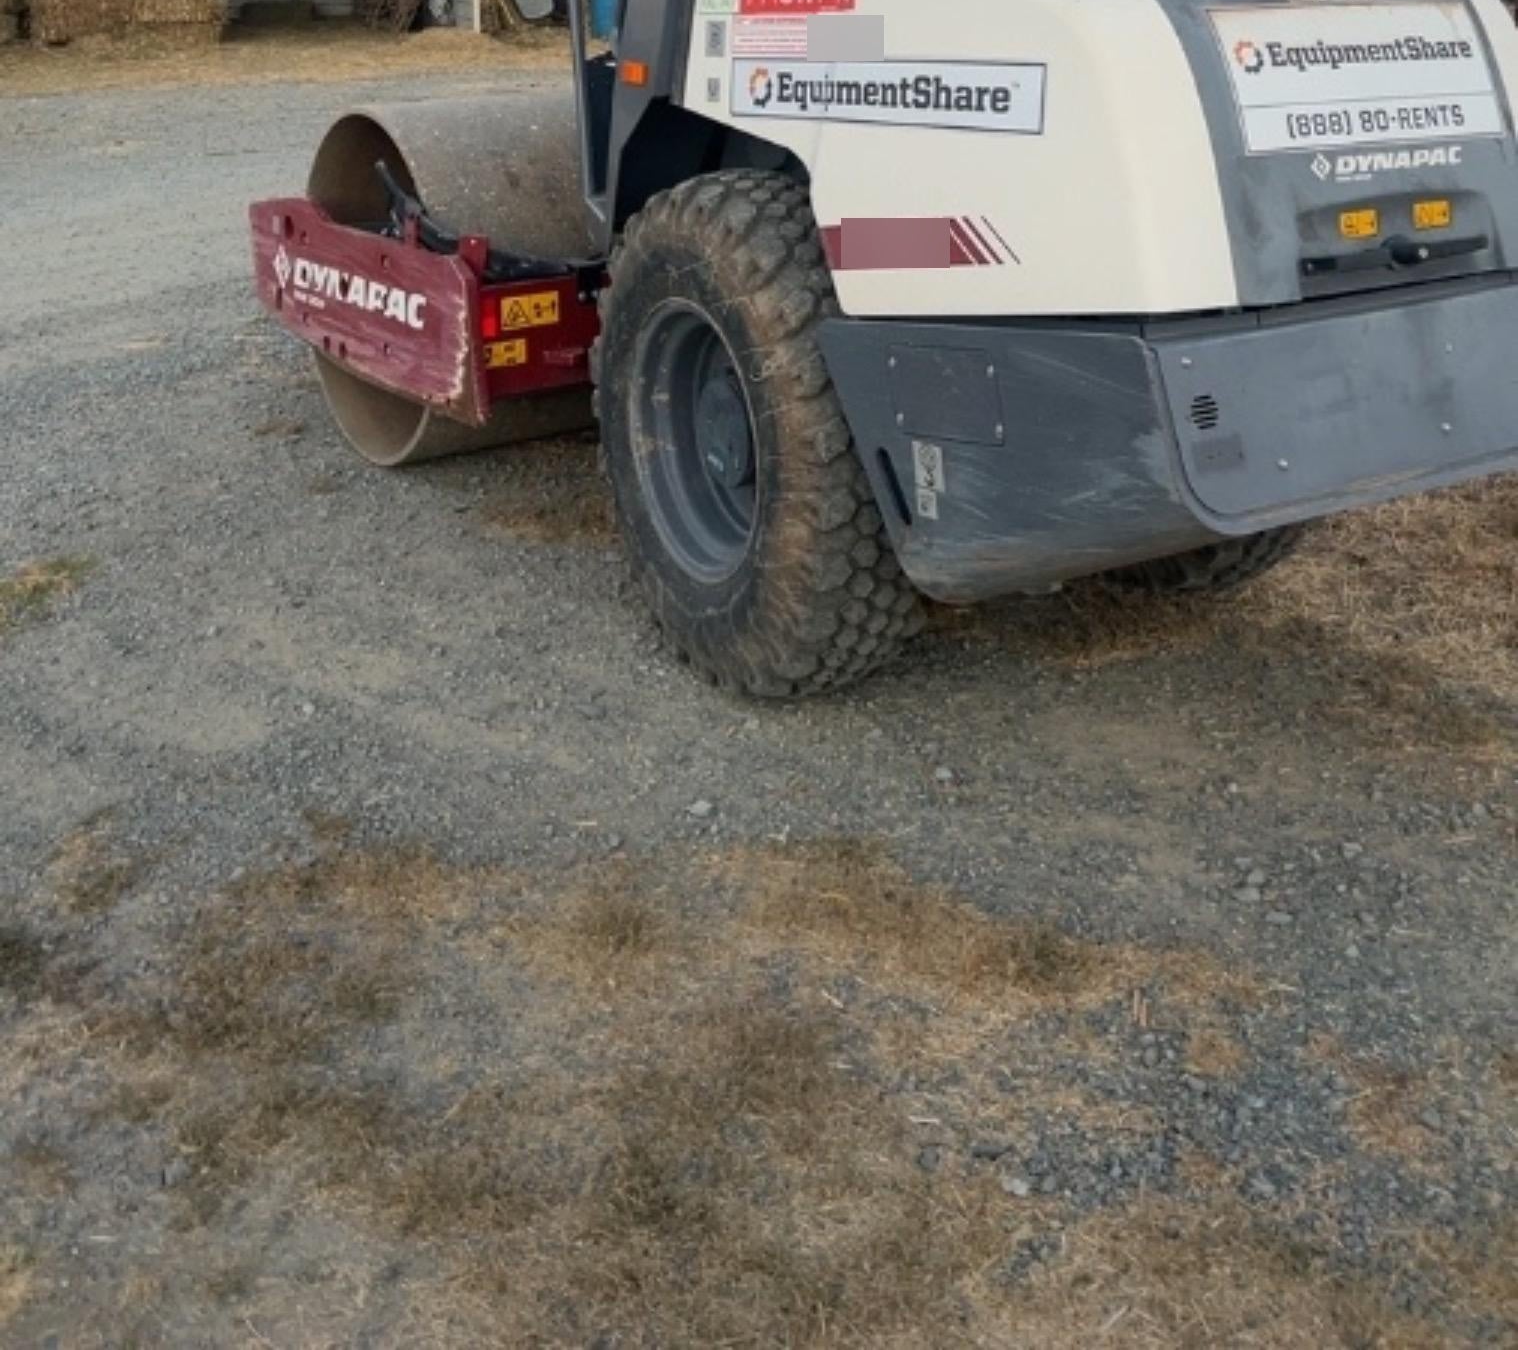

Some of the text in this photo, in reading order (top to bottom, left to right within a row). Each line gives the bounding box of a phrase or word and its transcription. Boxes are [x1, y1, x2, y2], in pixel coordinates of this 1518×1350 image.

[1265, 37, 1473, 72] EquipmentShare
[1334, 146, 1462, 175] DYNAPAC
[293, 256, 427, 330] DYNAPAC
